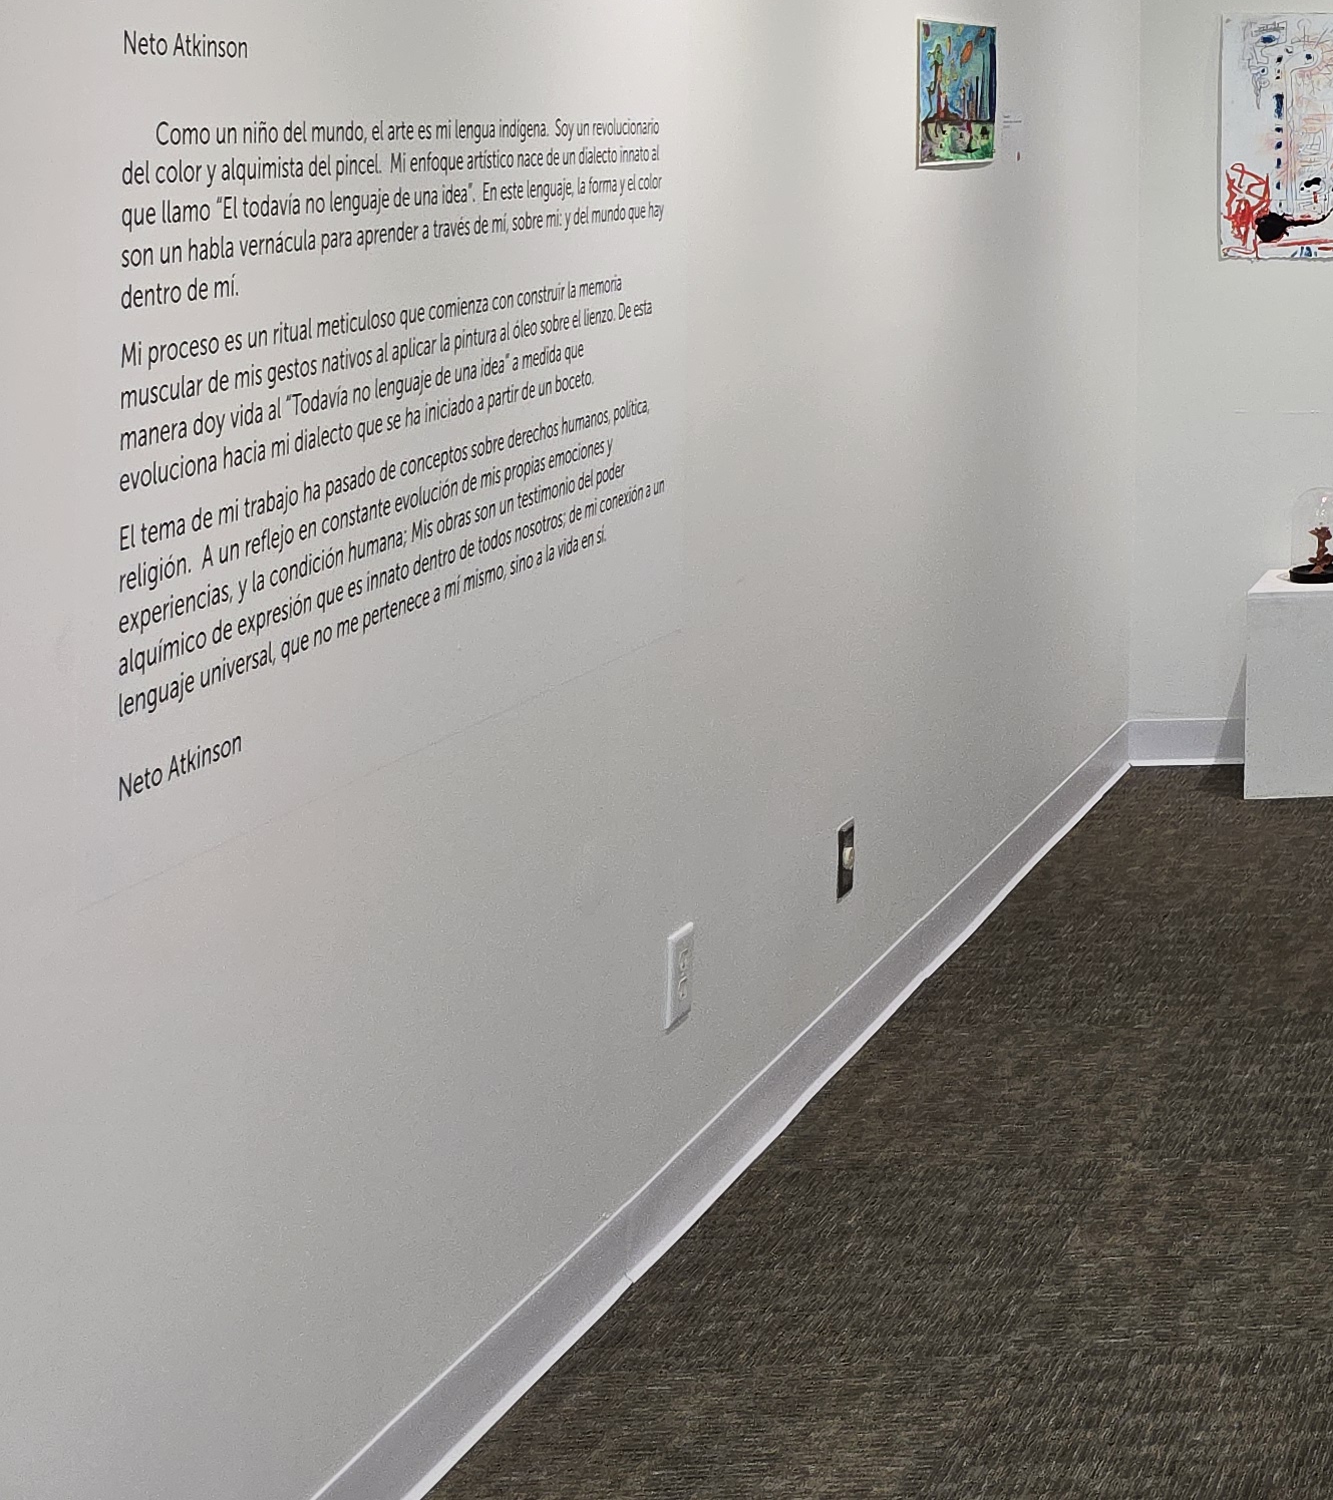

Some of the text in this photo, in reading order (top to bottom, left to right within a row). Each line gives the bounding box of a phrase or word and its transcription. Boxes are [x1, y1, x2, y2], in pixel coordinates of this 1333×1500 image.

[124, 30, 248, 59] Neto Atkinson
[156, 121, 211, 146] Como
[216, 126, 237, 145] un
[243, 120, 279, 144] niño
[283, 120, 307, 143] del
[311, 120, 367, 144] mundo,
[371, 119, 384, 141] el
[387, 121, 414, 141] arte
[417, 124, 432, 140] es
[435, 119, 452, 140] mi
[454, 119, 496, 144] lengua
[555, 118, 575, 142] Soy
[576, 122, 590, 137] un
[592, 117, 660, 136] revolucionario
[121, 273, 239, 310] dentro de mí.
[120, 420, 188, 452] manera
[193, 410, 226, 439] doy
[230, 401, 263, 429] vida
[268, 396, 282, 421] al
[352, 385, 371, 404] no
[375, 369, 432, 401] lenguaje
[434, 365, 452, 387] de
[454, 364, 477, 384] una
[512, 356, 519, 372] a
[521, 343, 562, 370] medida
[564, 343, 584, 365] que
[119, 523, 136, 552] El
[140, 517, 186, 545] tema
[191, 506, 213, 533] de
[218, 497, 239, 526] mi
[243, 485, 299, 518] trabajo
[303, 480, 321, 504] ha
[325, 465, 376, 504] pasado
[379, 459, 396, 483] de
[399, 445, 468, 477] conceptos
[470, 435, 505, 459] sobre
[507, 421, 559, 449] derechos
[561, 410, 611, 436] humanos,
[119, 735, 242, 802] Neto Atkinson
